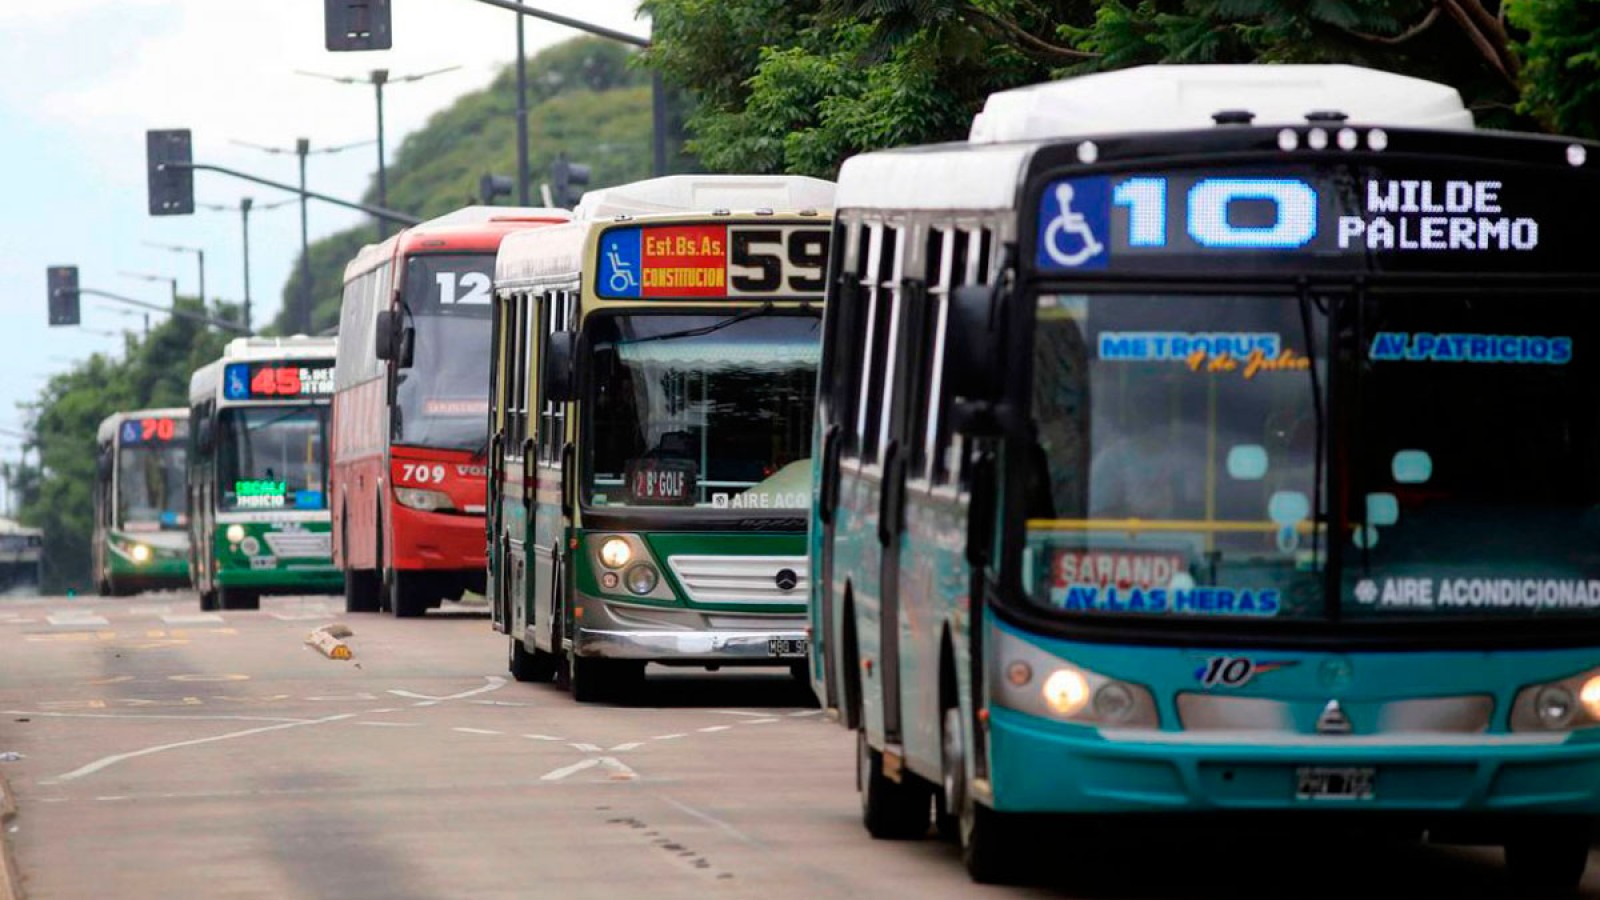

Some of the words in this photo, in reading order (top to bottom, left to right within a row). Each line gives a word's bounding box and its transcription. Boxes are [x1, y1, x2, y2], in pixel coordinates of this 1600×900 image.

[1367, 180, 1502, 213] WILDE
[1113, 177, 1318, 248] 10
[1338, 216, 1539, 250] PALERMO
[731, 229, 830, 293] 59
[435, 271, 492, 305] 12
[643, 267, 725, 288] CONSTITUCION
[1098, 331, 1282, 361] METROBUS
[1369, 332, 1572, 364] AV.PATRICIOS
[251, 367, 301, 395] 45
[141, 417, 175, 442] 70
[402, 464, 446, 485] 709
[659, 472, 685, 497] GOLF
[731, 493, 769, 509] AIRE
[1060, 553, 1184, 583] SARANDI
[1171, 586, 1281, 617] HERAS
[1381, 578, 1434, 605] AIRE
[1204, 656, 1254, 688] 10
